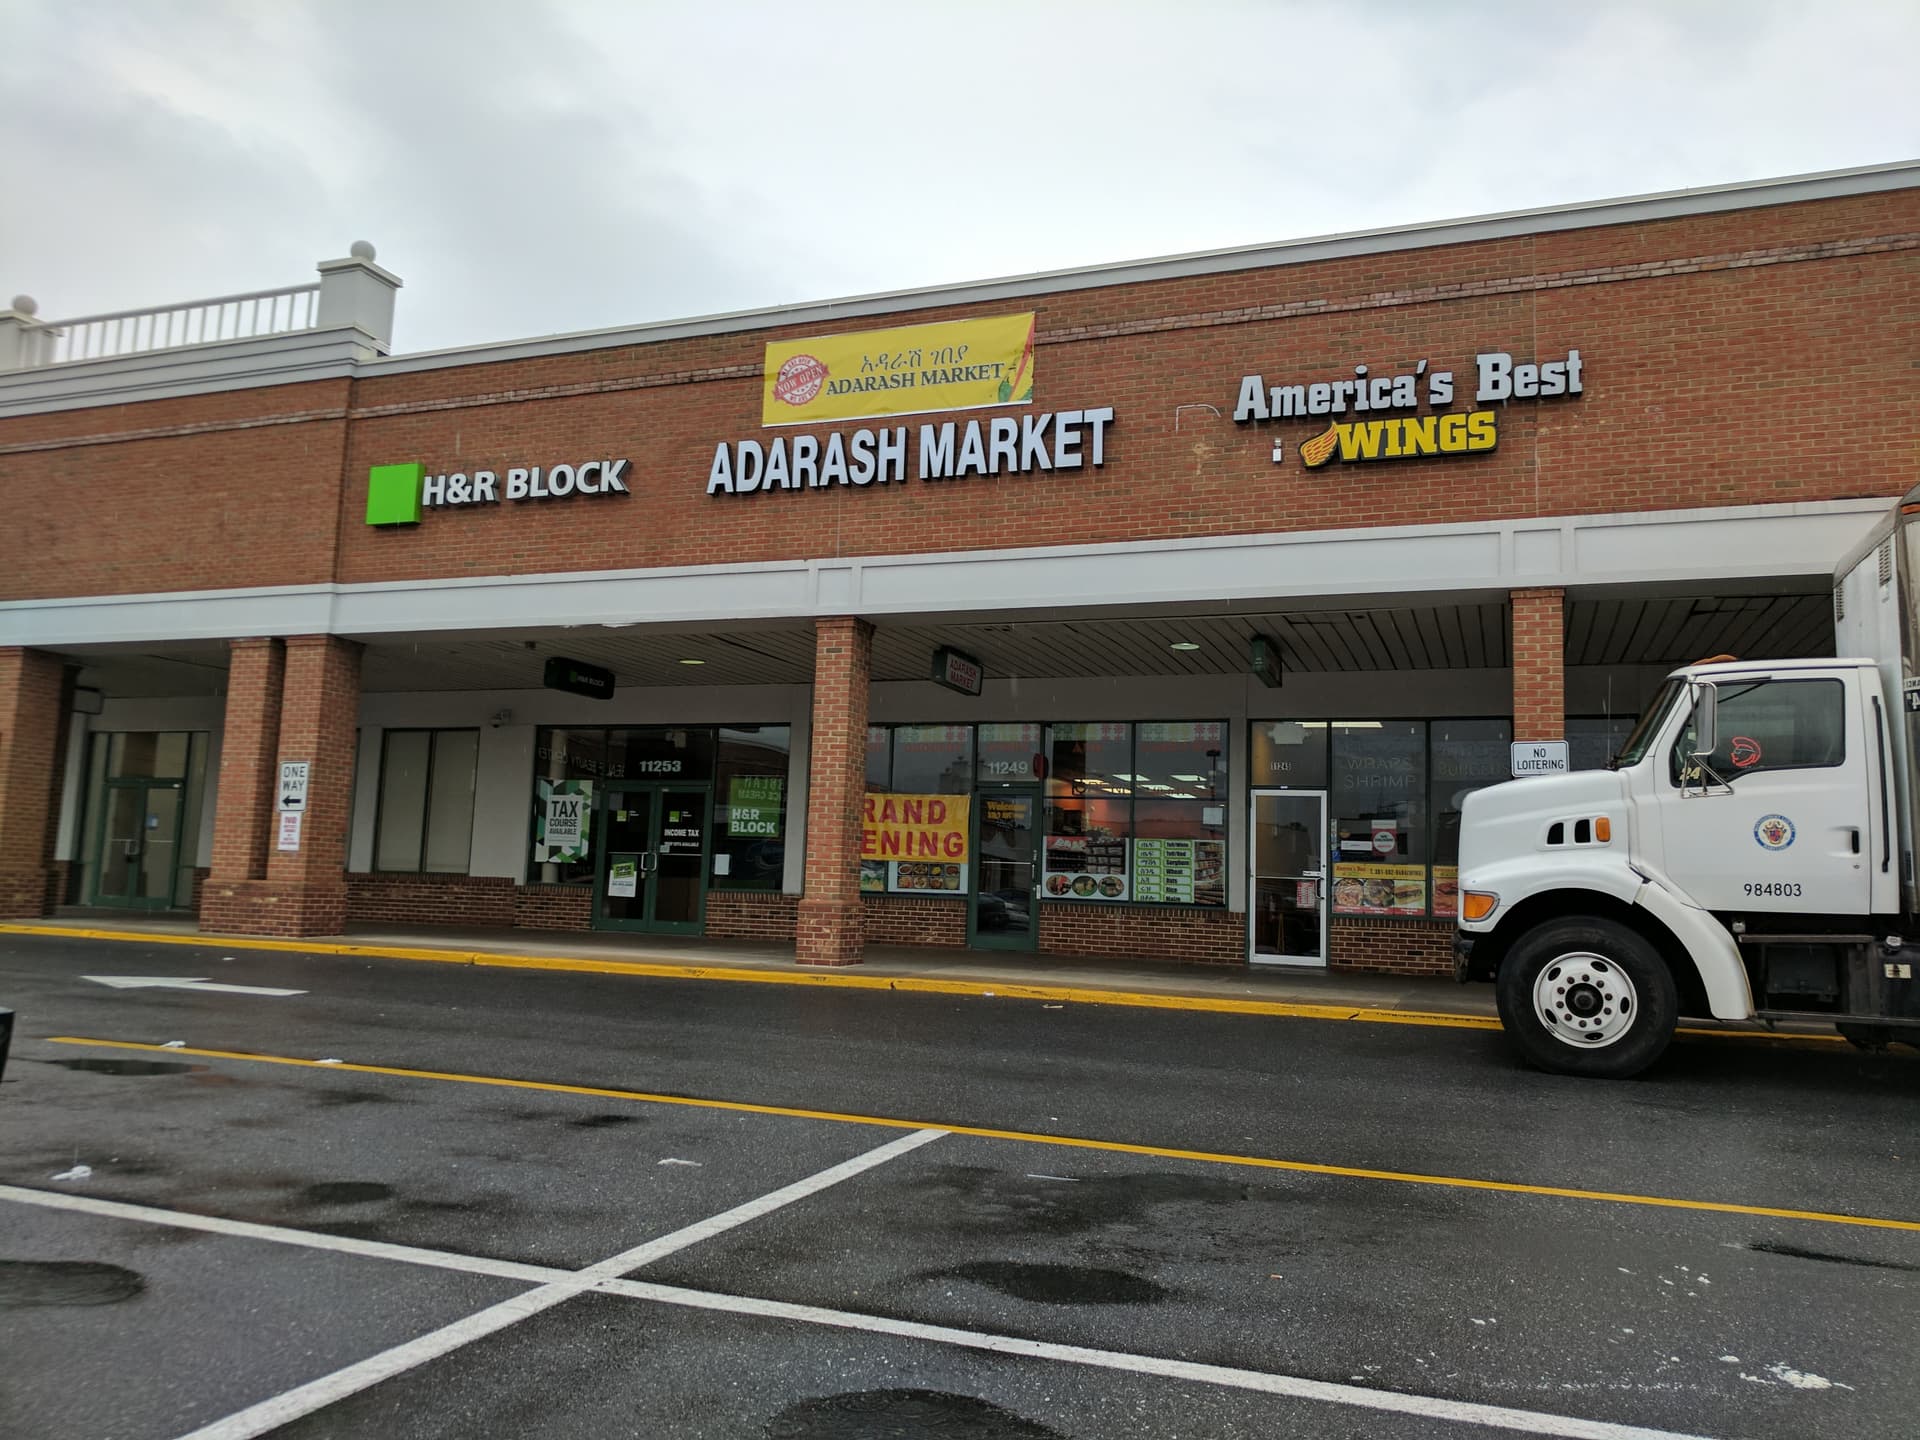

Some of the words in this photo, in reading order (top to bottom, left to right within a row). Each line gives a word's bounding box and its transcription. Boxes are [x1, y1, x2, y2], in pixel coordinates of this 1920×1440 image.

[800, 366, 823, 384] OPEN
[826, 372, 916, 395] ADARASH
[921, 362, 1005, 386] MARKET
[1233, 360, 1454, 422] America's
[1476, 350, 1583, 403] Best
[1336, 410, 1497, 462] WINGS
[706, 426, 907, 495] ADARASH
[919, 406, 1114, 480] MARKET
[422, 471, 498, 506] H&R
[506, 458, 631, 499] BLOCK
[1533, 748, 1547, 758] NO
[283, 766, 306, 778] ONE
[640, 760, 682, 773] 11253
[989, 761, 1028, 775] 11249
[1517, 760, 1564, 770] LOITERING
[1680, 767, 1700, 780] 24
[282, 781, 305, 792] WAY
[552, 801, 578, 818] TAX
[732, 808, 760, 820] H&R
[864, 799, 946, 824] RAND
[549, 818, 577, 828] COURSE
[731, 821, 776, 834] BLOCK
[664, 829, 687, 837] INCOME
[688, 829, 700, 837] TAX
[861, 829, 963, 858] ENING
[1744, 883, 1802, 897] 984803
